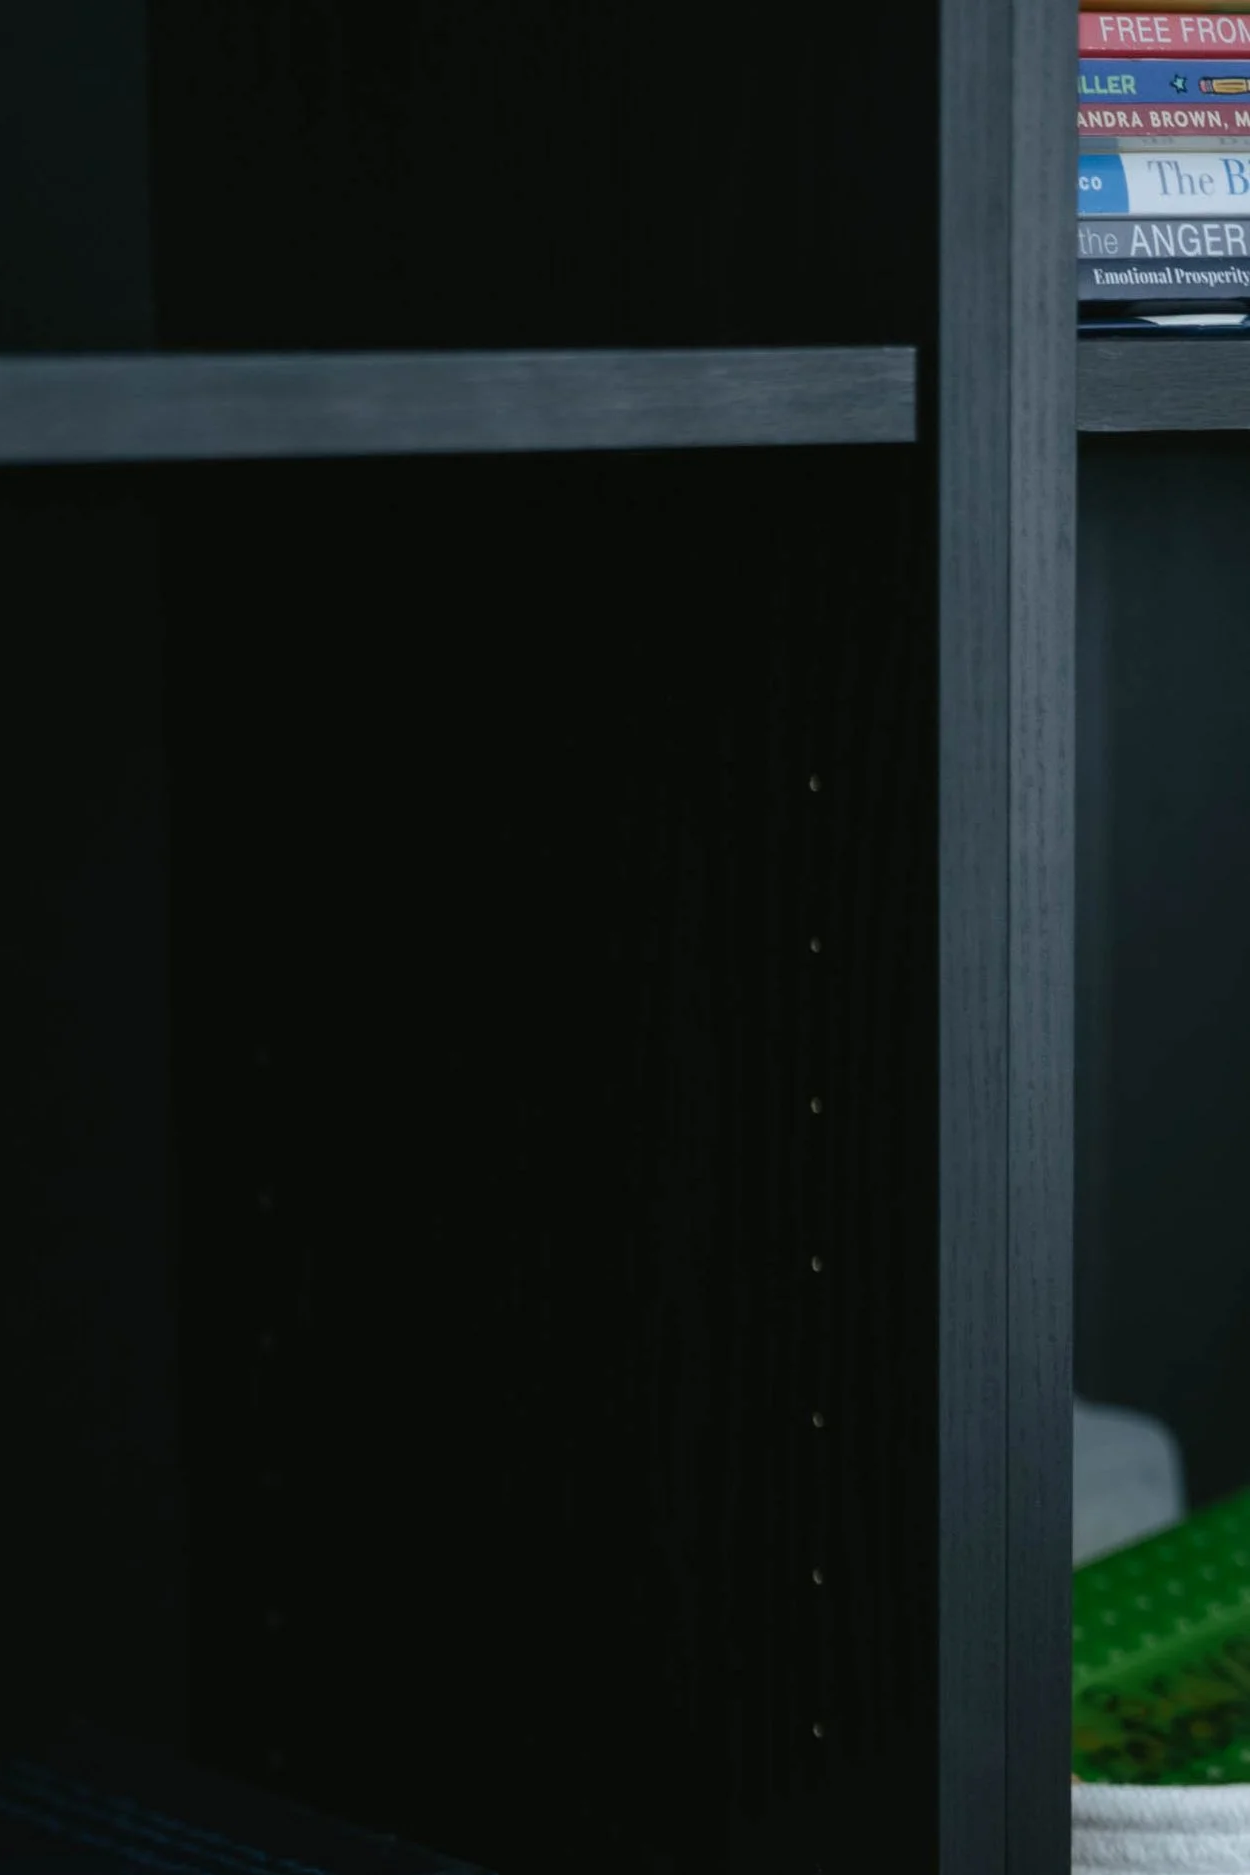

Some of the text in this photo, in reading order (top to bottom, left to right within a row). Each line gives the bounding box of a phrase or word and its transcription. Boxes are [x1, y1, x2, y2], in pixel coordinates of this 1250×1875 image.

[1099, 16, 1172, 43] FREE
[1077, 111, 1144, 128] ANDRA
[1149, 110, 1229, 131] BROWN,
[1147, 158, 1250, 196] The B
[1078, 223, 1248, 258] the ANGER
[1093, 267, 1173, 286] Emotional
